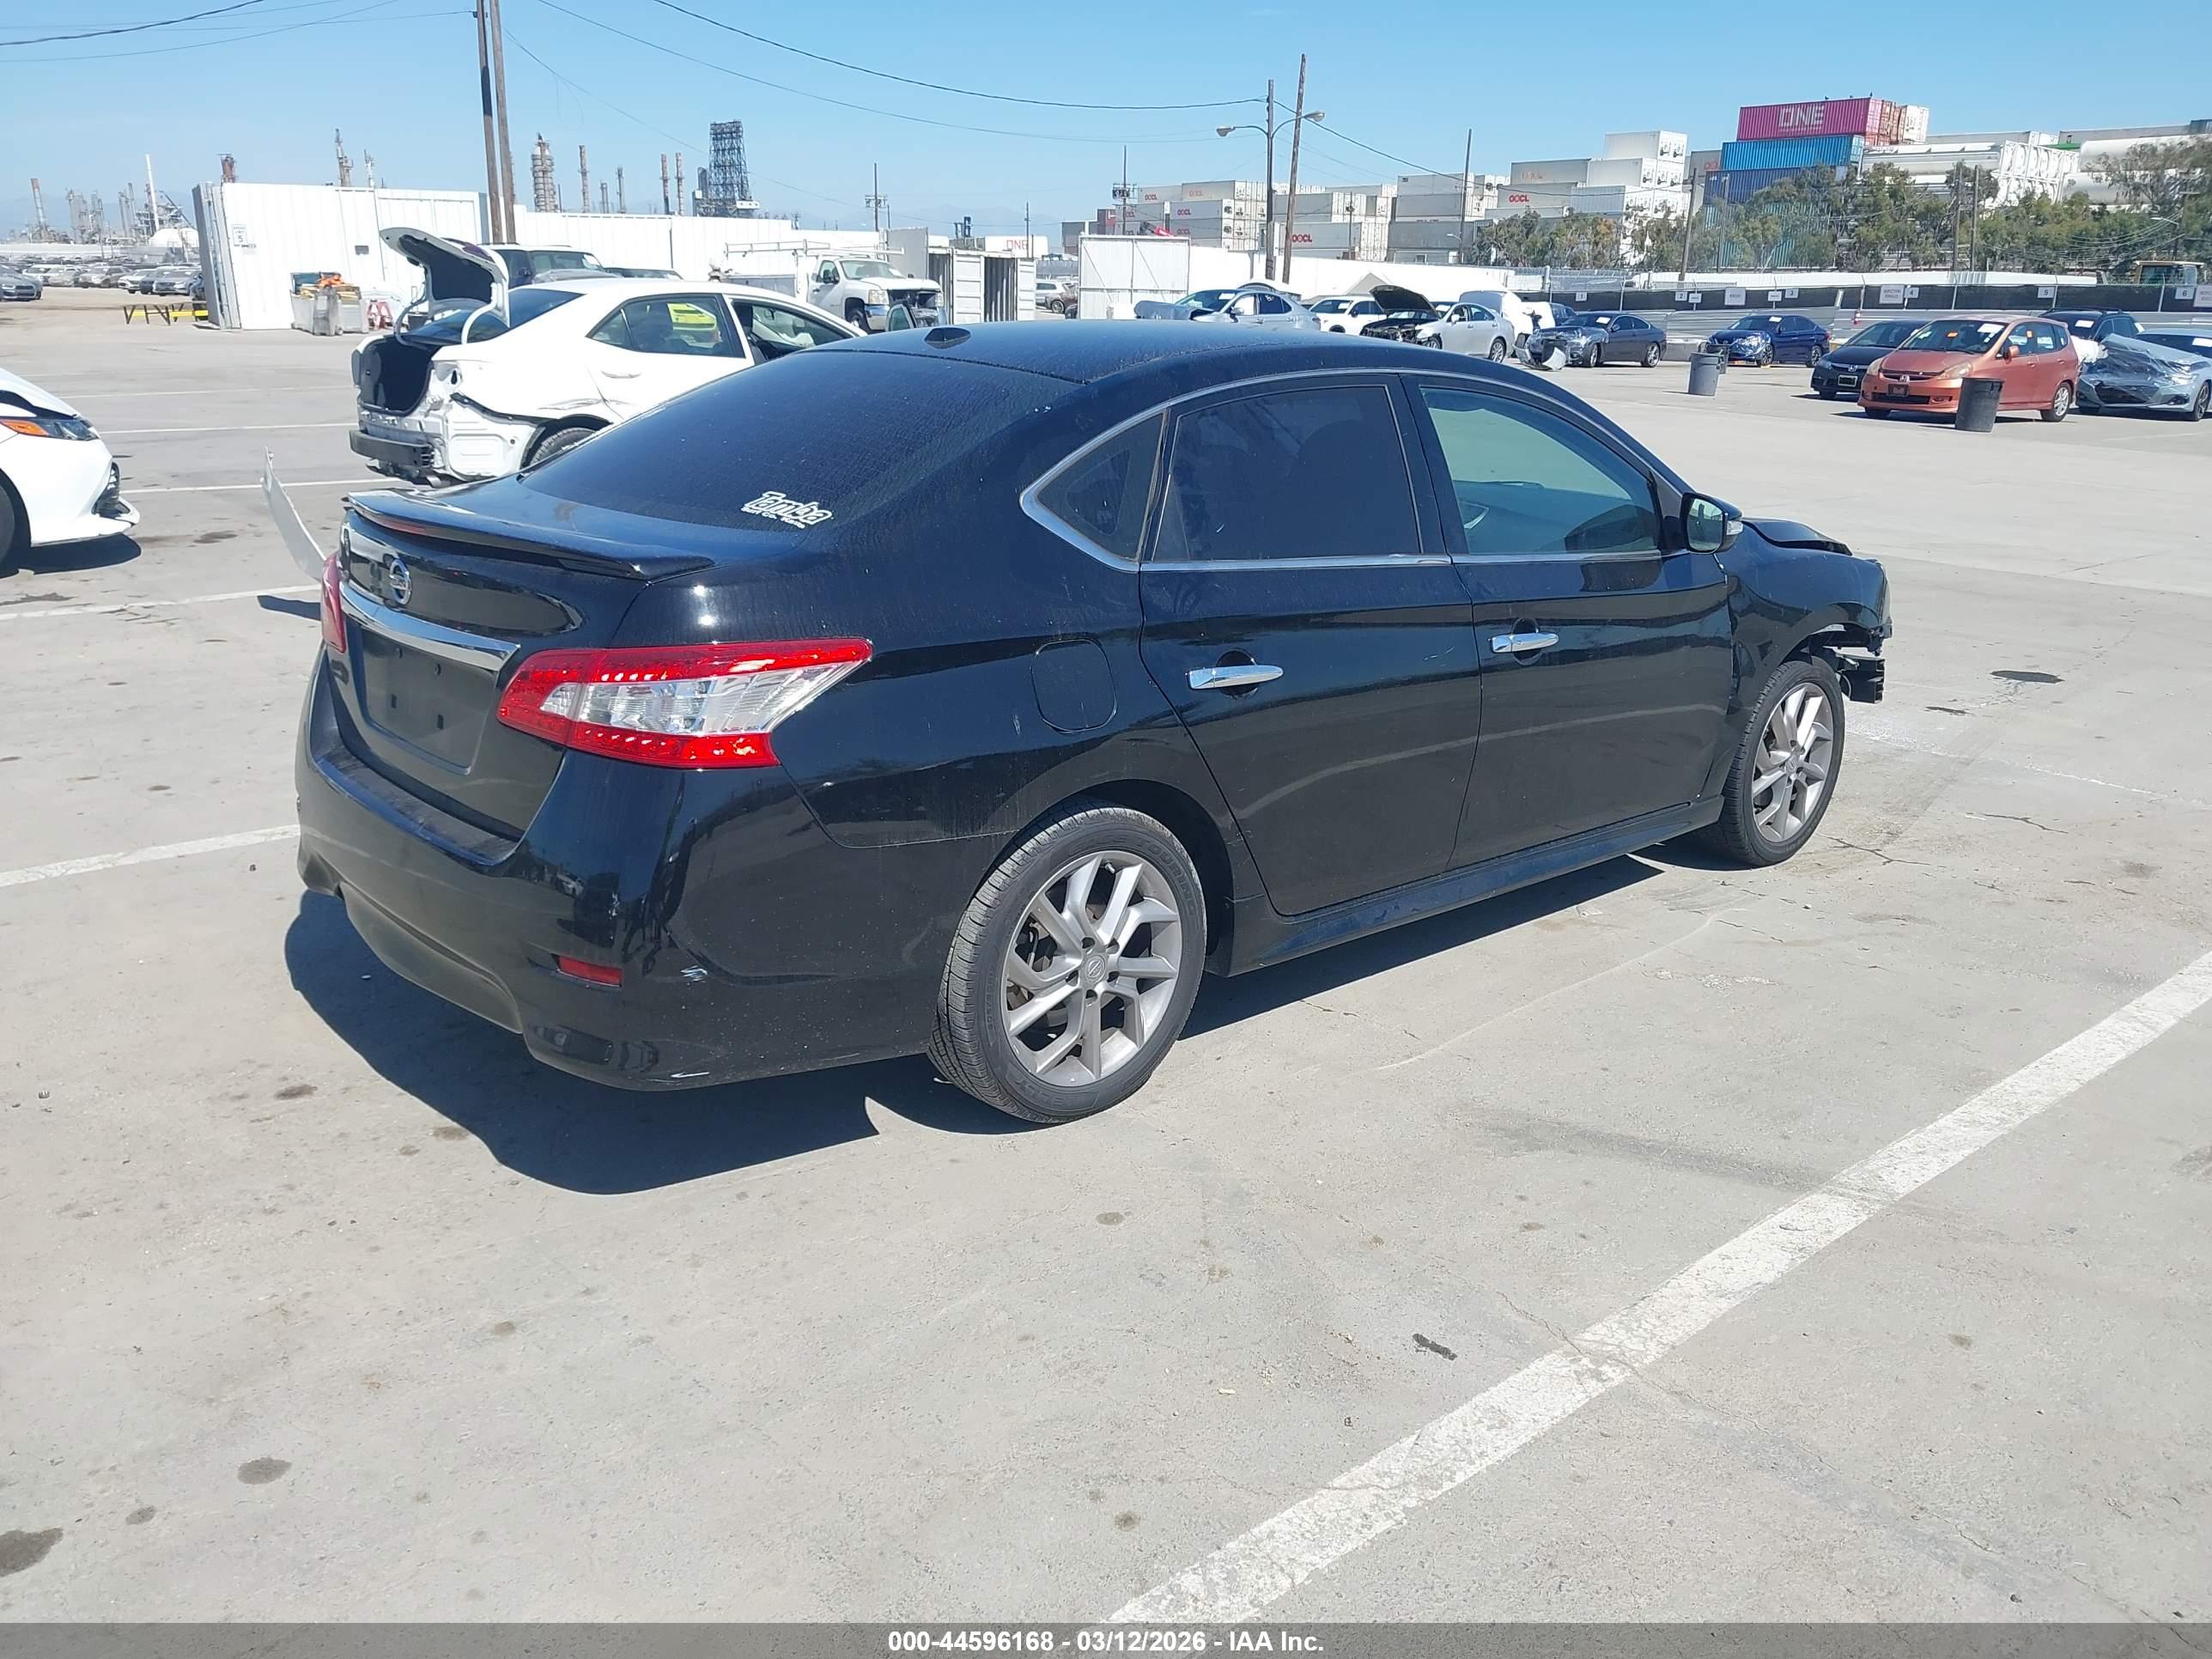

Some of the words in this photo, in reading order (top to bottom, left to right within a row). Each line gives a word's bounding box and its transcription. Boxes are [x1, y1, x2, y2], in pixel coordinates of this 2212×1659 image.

[1778, 105, 1826, 128] ONE
[1509, 194, 1530, 203] OOCL
[1291, 234, 1313, 243] OOCL
[744, 490, 833, 526] Tamba
